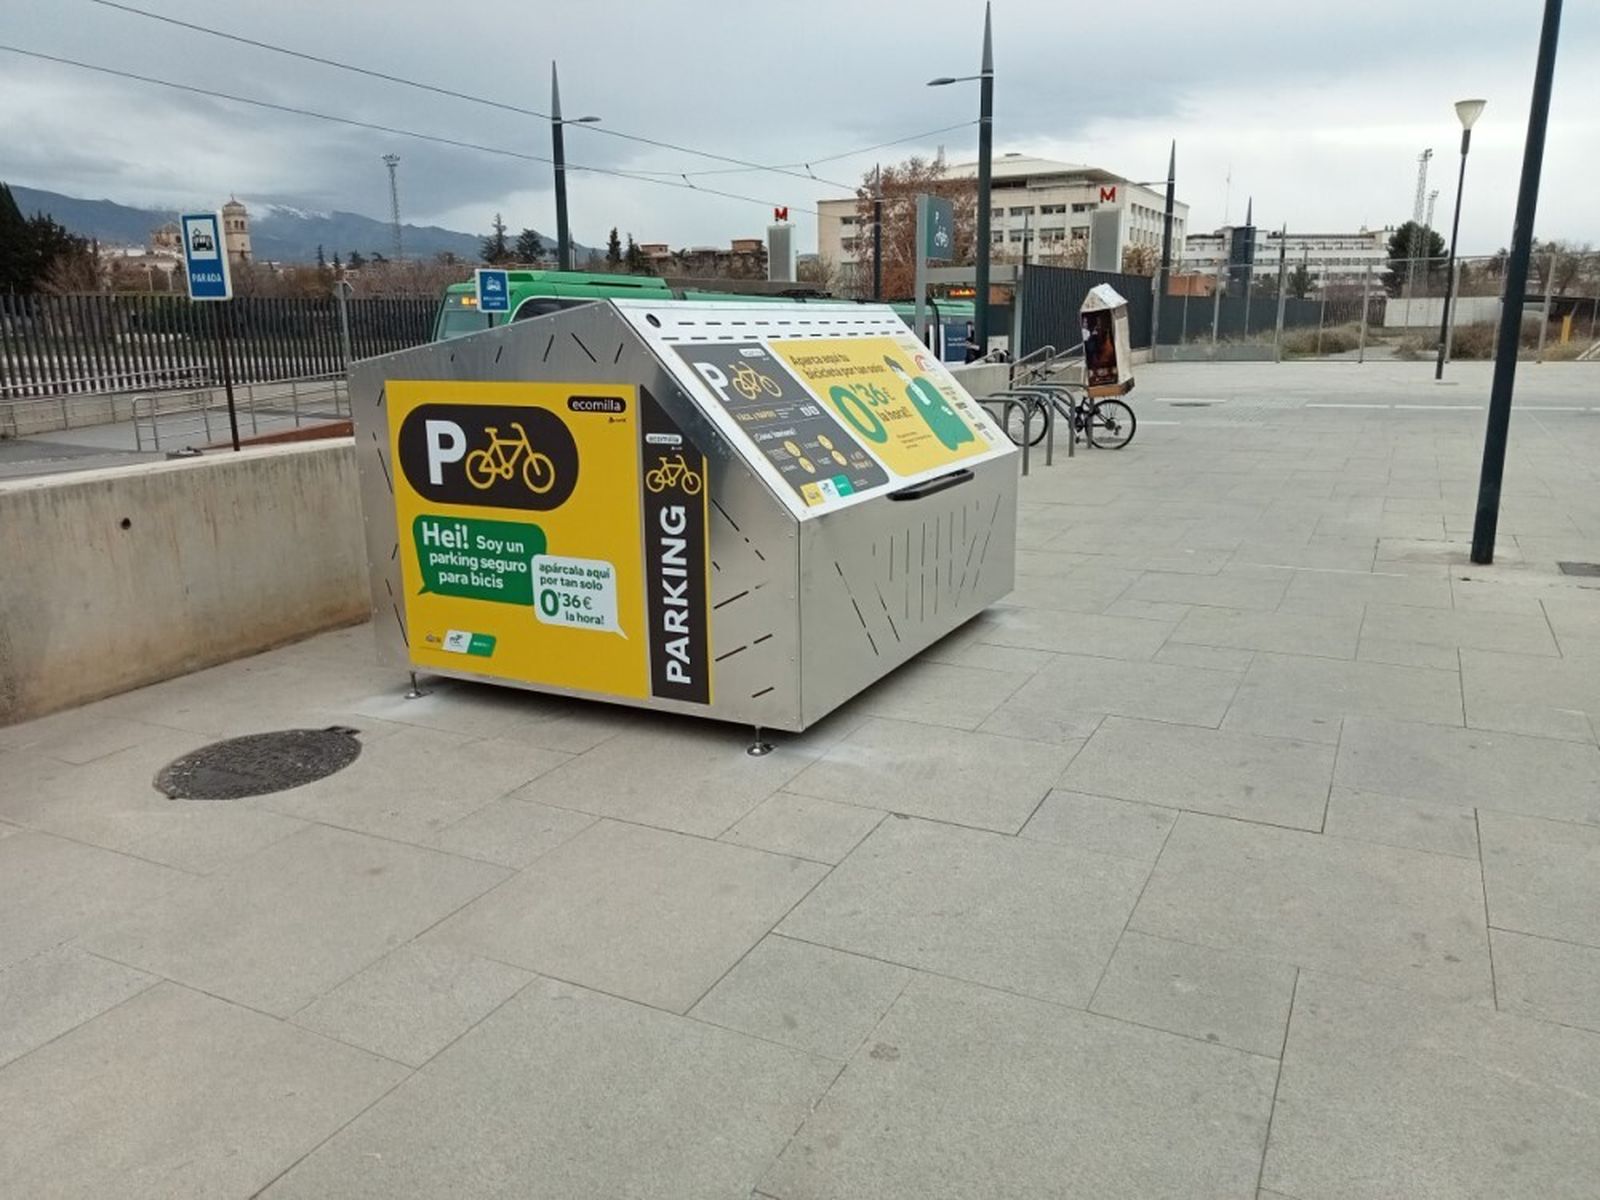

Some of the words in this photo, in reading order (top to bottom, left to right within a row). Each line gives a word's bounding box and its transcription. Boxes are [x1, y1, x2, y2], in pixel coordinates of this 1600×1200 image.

[1100, 186, 1116, 203] M
[774, 206, 788, 221] M
[192, 272, 222, 282] PARADA
[692, 362, 731, 401] P
[571, 399, 621, 412] ecomilla
[425, 419, 467, 485] P
[421, 521, 469, 549] Hei!
[476, 535, 504, 554] Soy
[507, 541, 524, 553] un
[429, 551, 479, 571] parking
[480, 557, 527, 573] seguro
[539, 562, 584, 576] apárcala
[586, 567, 610, 580] aquí
[439, 571, 469, 585] para
[471, 572, 504, 589] bicis
[540, 576, 558, 586] por
[560, 577, 579, 588] tan
[579, 579, 603, 591] solo
[660, 506, 692, 684] PARKING
[565, 611, 575, 622] la
[576, 611, 605, 625] hora!
